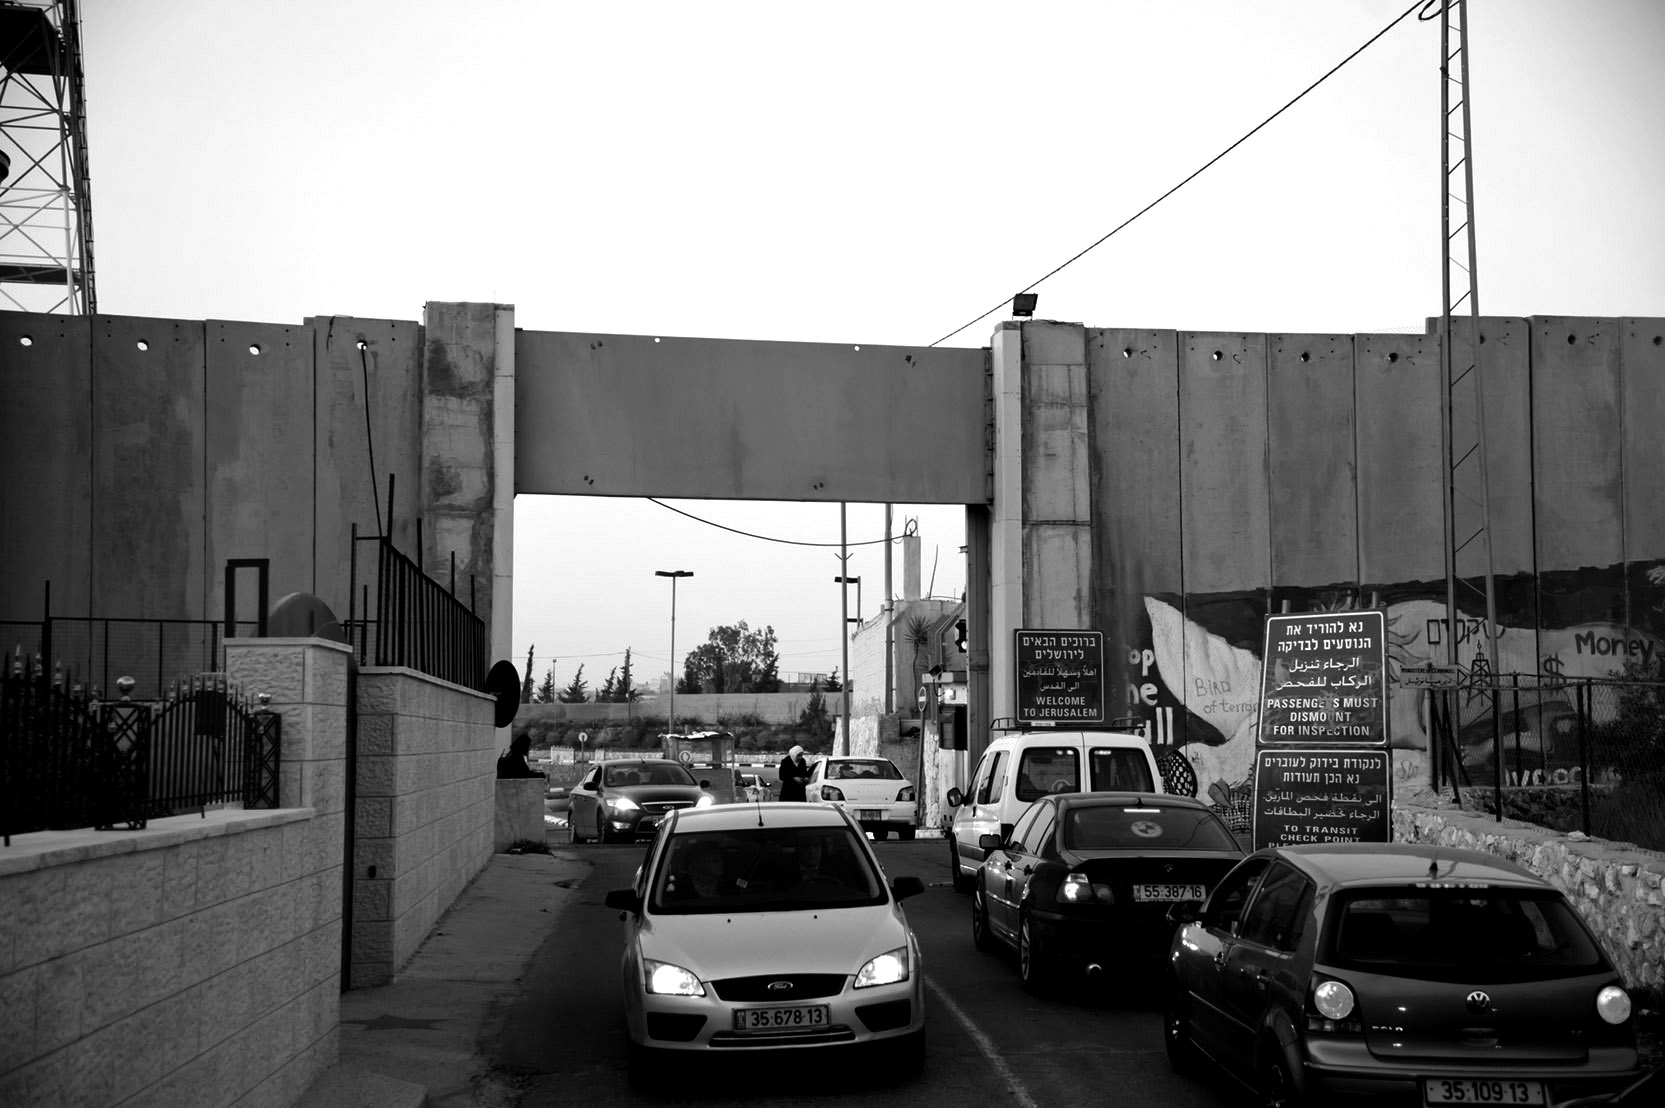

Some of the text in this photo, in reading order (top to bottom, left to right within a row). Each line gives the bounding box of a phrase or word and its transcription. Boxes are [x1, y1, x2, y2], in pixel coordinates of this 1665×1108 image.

[1286, 620, 1364, 636] נא להוריד את
[1022, 636, 1096, 647] ברוכים הבאים
[1277, 637, 1372, 653] הנוסעים לבדיקה
[1574, 630, 1654, 665] Money
[1035, 648, 1085, 660] לירושלים
[1288, 656, 1360, 673] الرجاء تنزيل
[1275, 674, 1372, 691] الركاب للفحص
[1035, 696, 1086, 706] WELCOME
[1203, 700, 1217, 714] of
[1266, 697, 1379, 709] PASSENGES MUST
[1023, 708, 1098, 718] TO JERUSALEM
[1289, 711, 1352, 722] DISMONT
[1273, 725, 1370, 737] FOR INSPECTION
[1264, 756, 1381, 771] לנקודת בידוק לעוברים
[1283, 772, 1360, 785] נא הכן תעודות
[1295, 792, 1329, 804] فحص
[1331, 792, 1362, 803] نقطة
[1264, 806, 1311, 819] البطاقات
[1348, 809, 1380, 822] الرجاء
[1283, 824, 1358, 835] TO TRANSIT
[1280, 834, 1318, 842] CHECK
